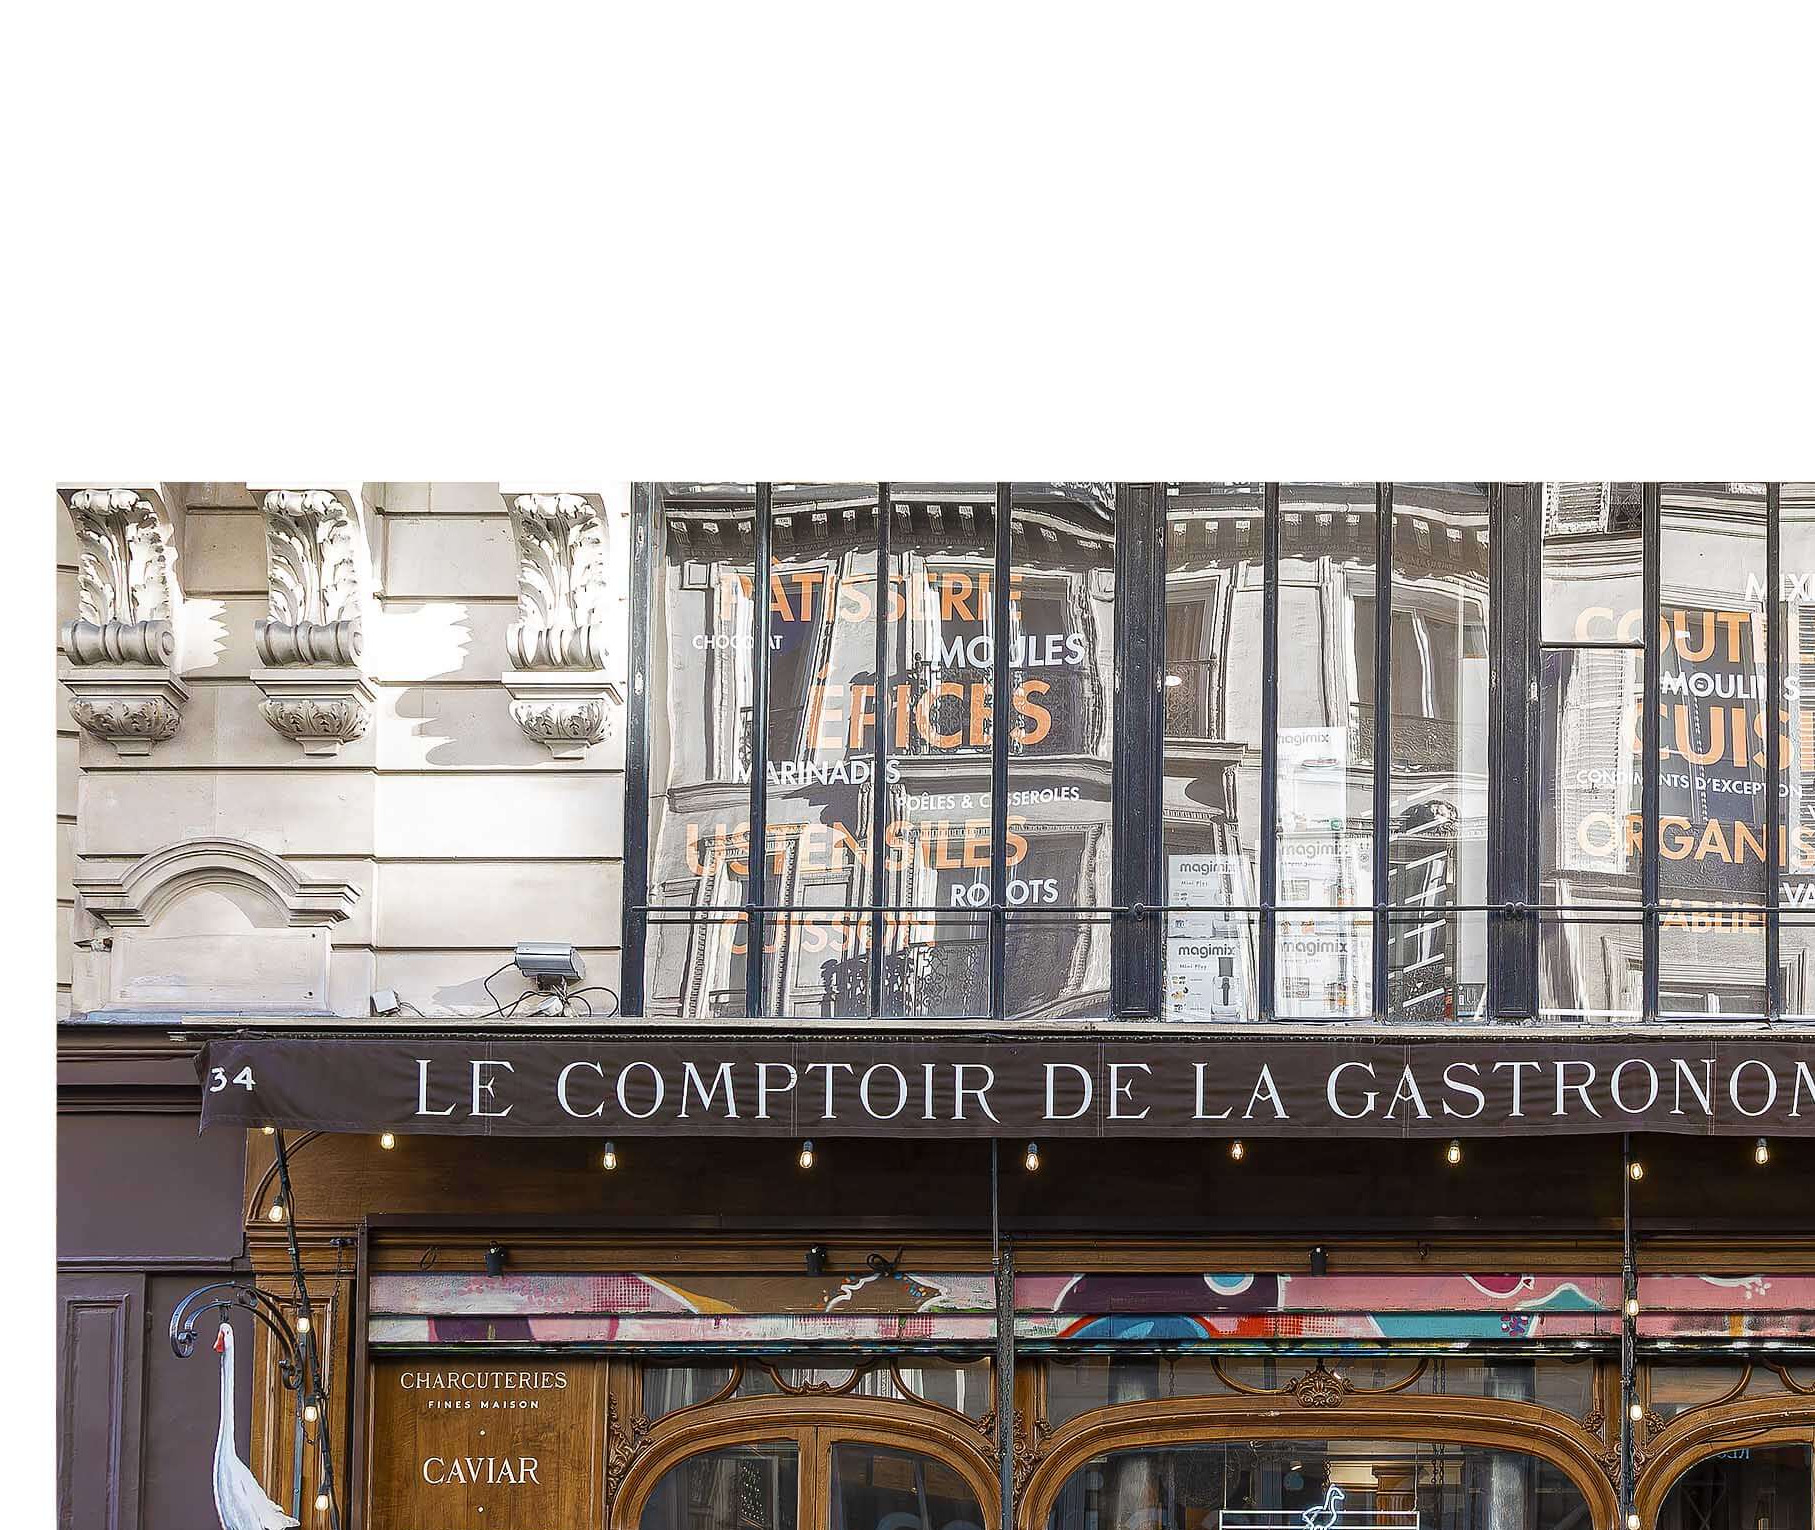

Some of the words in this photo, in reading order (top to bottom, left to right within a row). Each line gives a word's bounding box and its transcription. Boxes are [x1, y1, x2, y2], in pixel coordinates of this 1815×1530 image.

[732, 759, 901, 785] MARINADS
[961, 794, 975, 809] &
[951, 878, 1059, 907] ROOTS
[210, 1066, 256, 1093] 34
[415, 1059, 515, 1117] LE
[557, 1060, 1000, 1123] COMPTOIR
[1042, 1061, 1152, 1120] DE
[1191, 1062, 1290, 1119] LA
[400, 1371, 568, 1391] CHARCUTERIES
[428, 1400, 471, 1409] FINES
[480, 1400, 540, 1409] MAISON
[423, 1457, 540, 1486] CAVIAR
